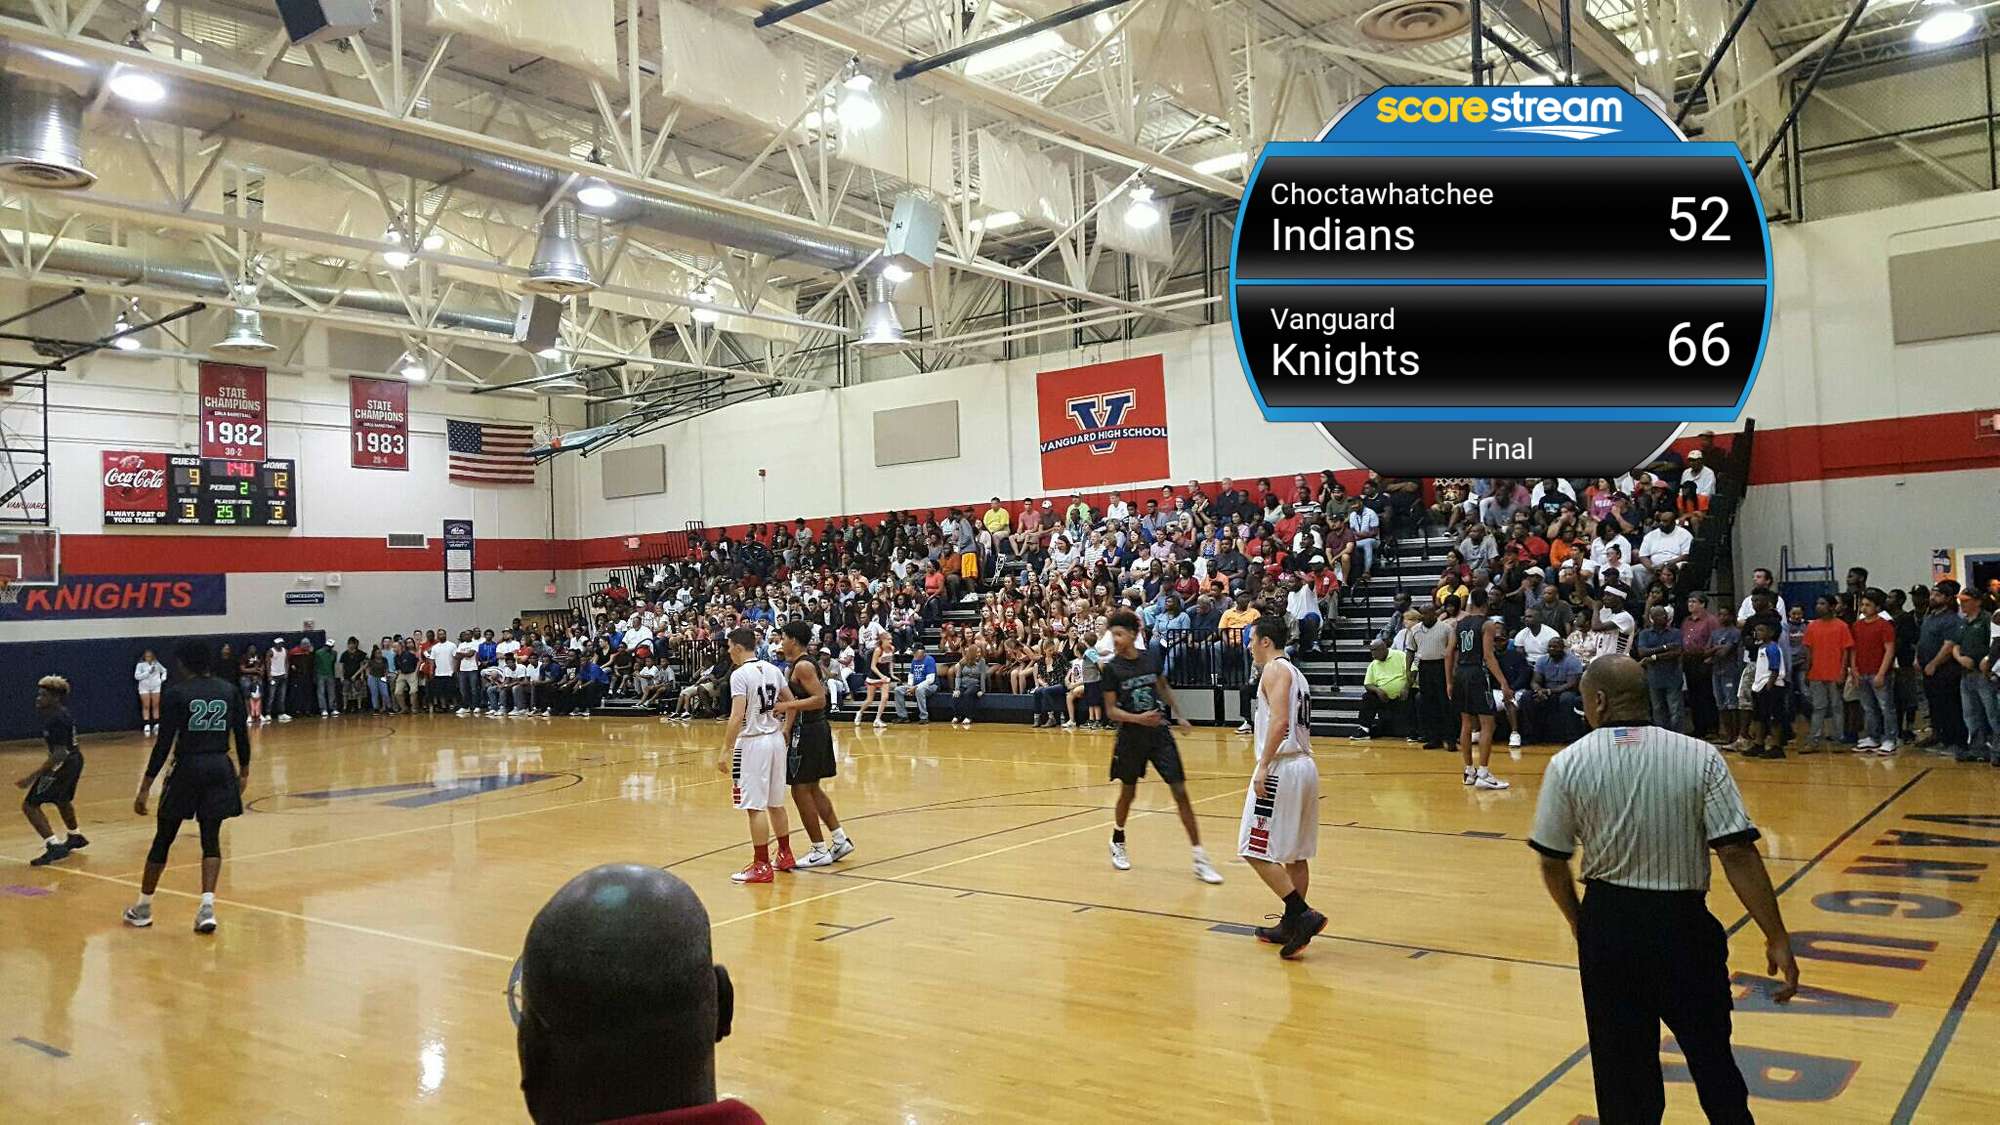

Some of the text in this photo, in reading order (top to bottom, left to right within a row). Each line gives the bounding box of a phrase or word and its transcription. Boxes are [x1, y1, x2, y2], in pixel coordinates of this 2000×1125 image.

[219, 387, 247, 399] STATE
[204, 396, 261, 411] CHAMPIONS
[367, 400, 392, 411] STATE
[354, 409, 404, 422] CHAMPIONS
[205, 421, 263, 446] 1982
[1040, 426, 1168, 453] VANGUARD HIGH SCHOOL
[355, 431, 404, 454] 1983
[263, 462, 288, 470] HOME
[104, 468, 166, 488] Coca-Cola
[189, 469, 200, 486] 9
[274, 472, 288, 488] 12
[240, 482, 248, 495] 2
[185, 504, 195, 517] 3
[216, 505, 234, 518] 25
[273, 506, 284, 519] 2
[25, 580, 193, 612] KNIGHTS
[187, 699, 228, 731] 22
